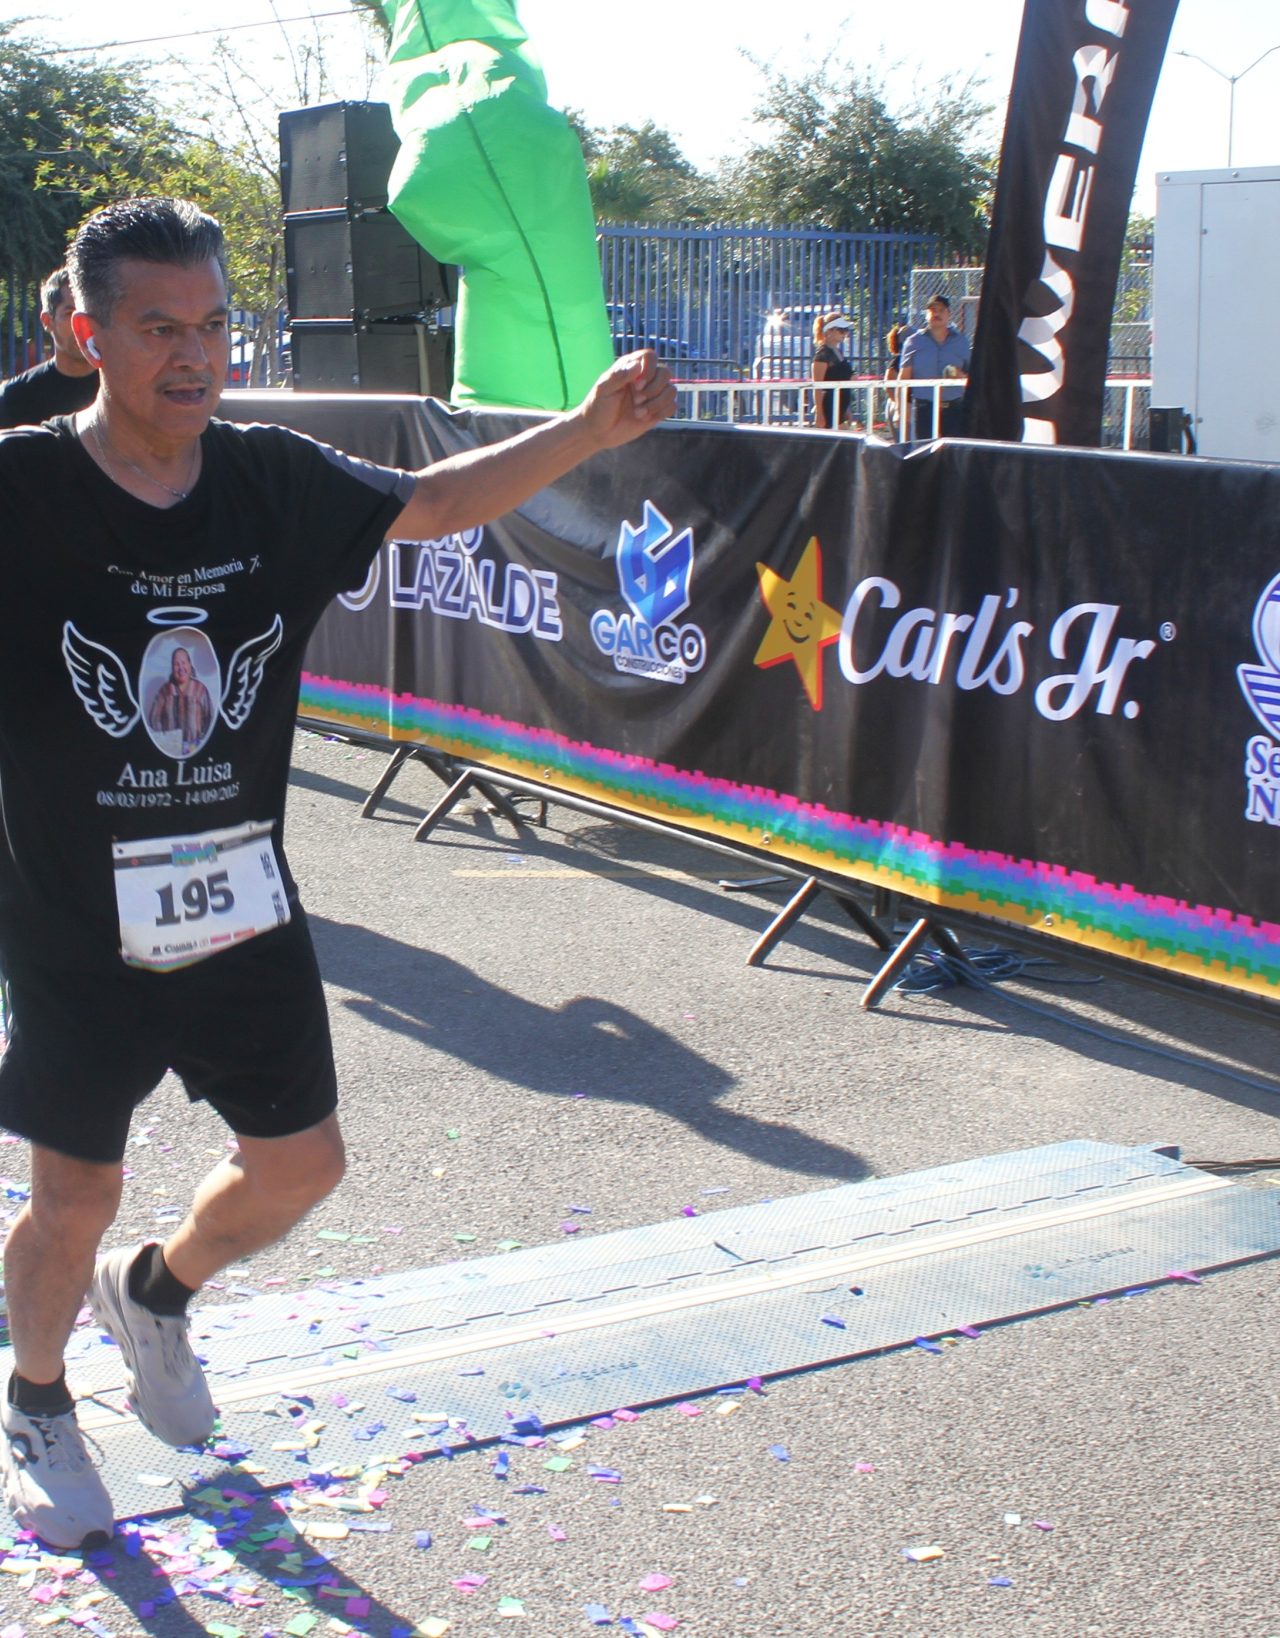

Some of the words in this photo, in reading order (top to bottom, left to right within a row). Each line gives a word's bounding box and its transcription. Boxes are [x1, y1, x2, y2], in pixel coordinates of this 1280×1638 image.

[1019, 0, 1129, 444] WER
[131, 580, 148, 595] de
[152, 582, 172, 597] Mi
[177, 582, 226, 599] Esposa
[177, 572, 192, 584] en
[193, 558, 244, 581] Memoria
[388, 542, 563, 642] LAZALDE
[590, 609, 706, 673] GARCO
[838, 576, 1034, 695] Carl's
[1034, 602, 1156, 722] Jr.
[116, 762, 169, 788] Ana
[175, 757, 233, 786] Luisa
[156, 870, 235, 927] 195
